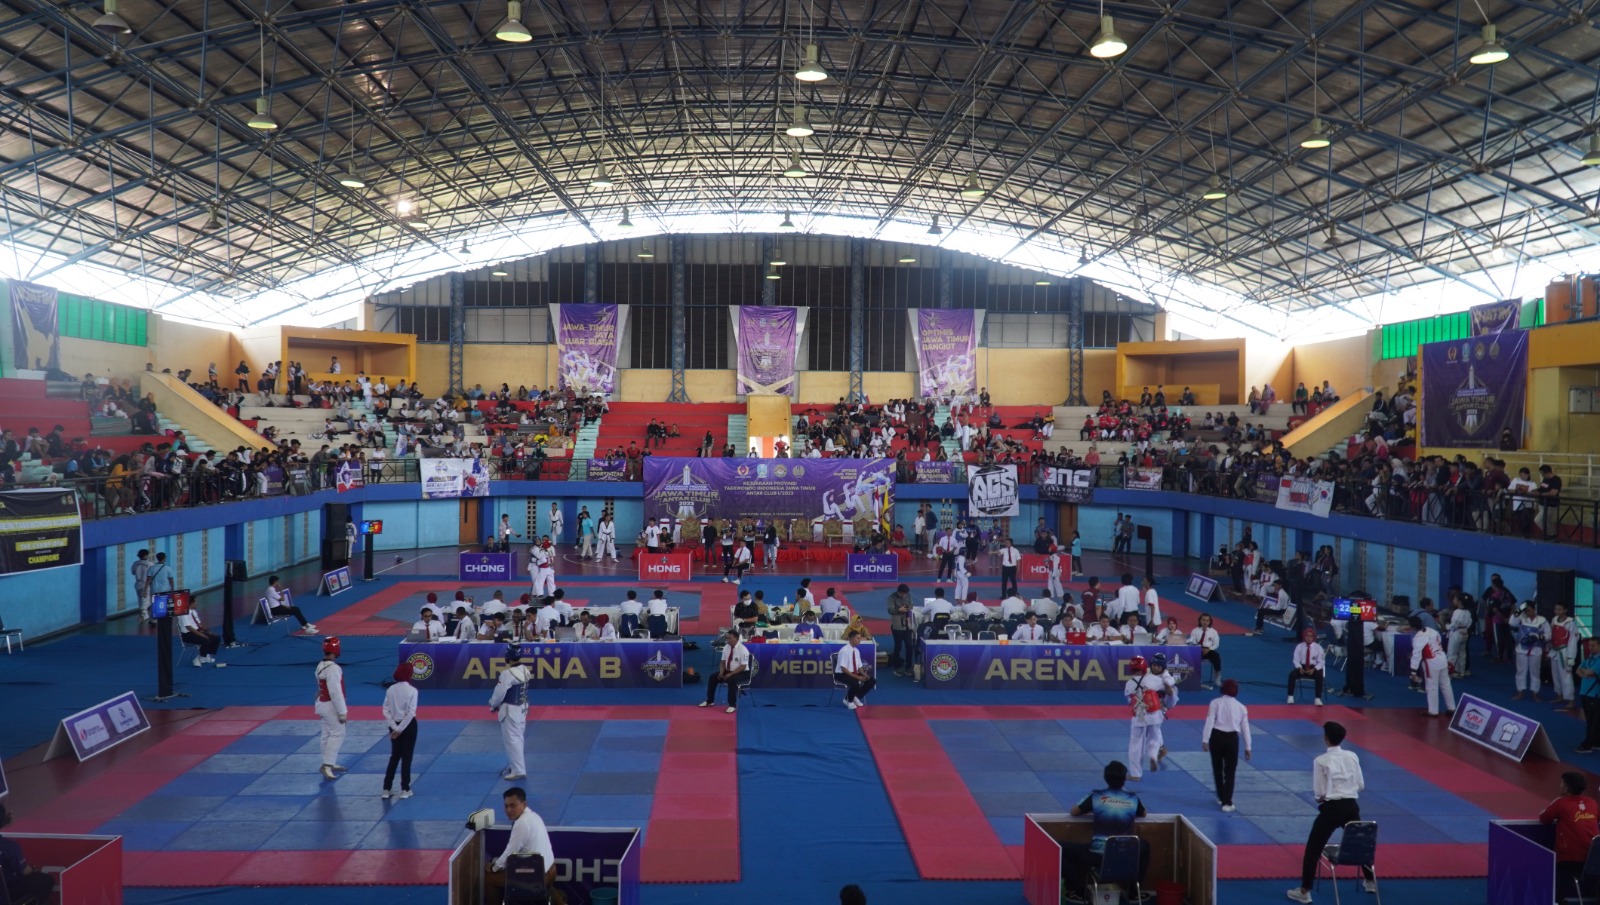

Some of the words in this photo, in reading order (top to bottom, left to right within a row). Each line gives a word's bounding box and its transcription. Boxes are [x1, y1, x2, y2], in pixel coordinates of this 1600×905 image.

[588, 324, 615, 332] TIMUR
[594, 331, 614, 339] JAYA
[923, 335, 943, 343] JAWA
[946, 335, 970, 343] TIMUR
[565, 337, 586, 345] LUAR
[588, 338, 615, 346] BIASA
[922, 343, 956, 351] BANGKIT
[655, 490, 684, 499] JAWA
[685, 490, 719, 499] TIMUR
[974, 494, 1016, 509] TAEKWONDO
[465, 564, 505, 573] CHONG
[648, 564, 681, 573] HONG
[853, 564, 893, 573] CHONG
[1339, 604, 1350, 612] 22
[1361, 605, 1371, 613] 17
[600, 656, 622, 679] B
[984, 658, 1106, 681] ARENA
